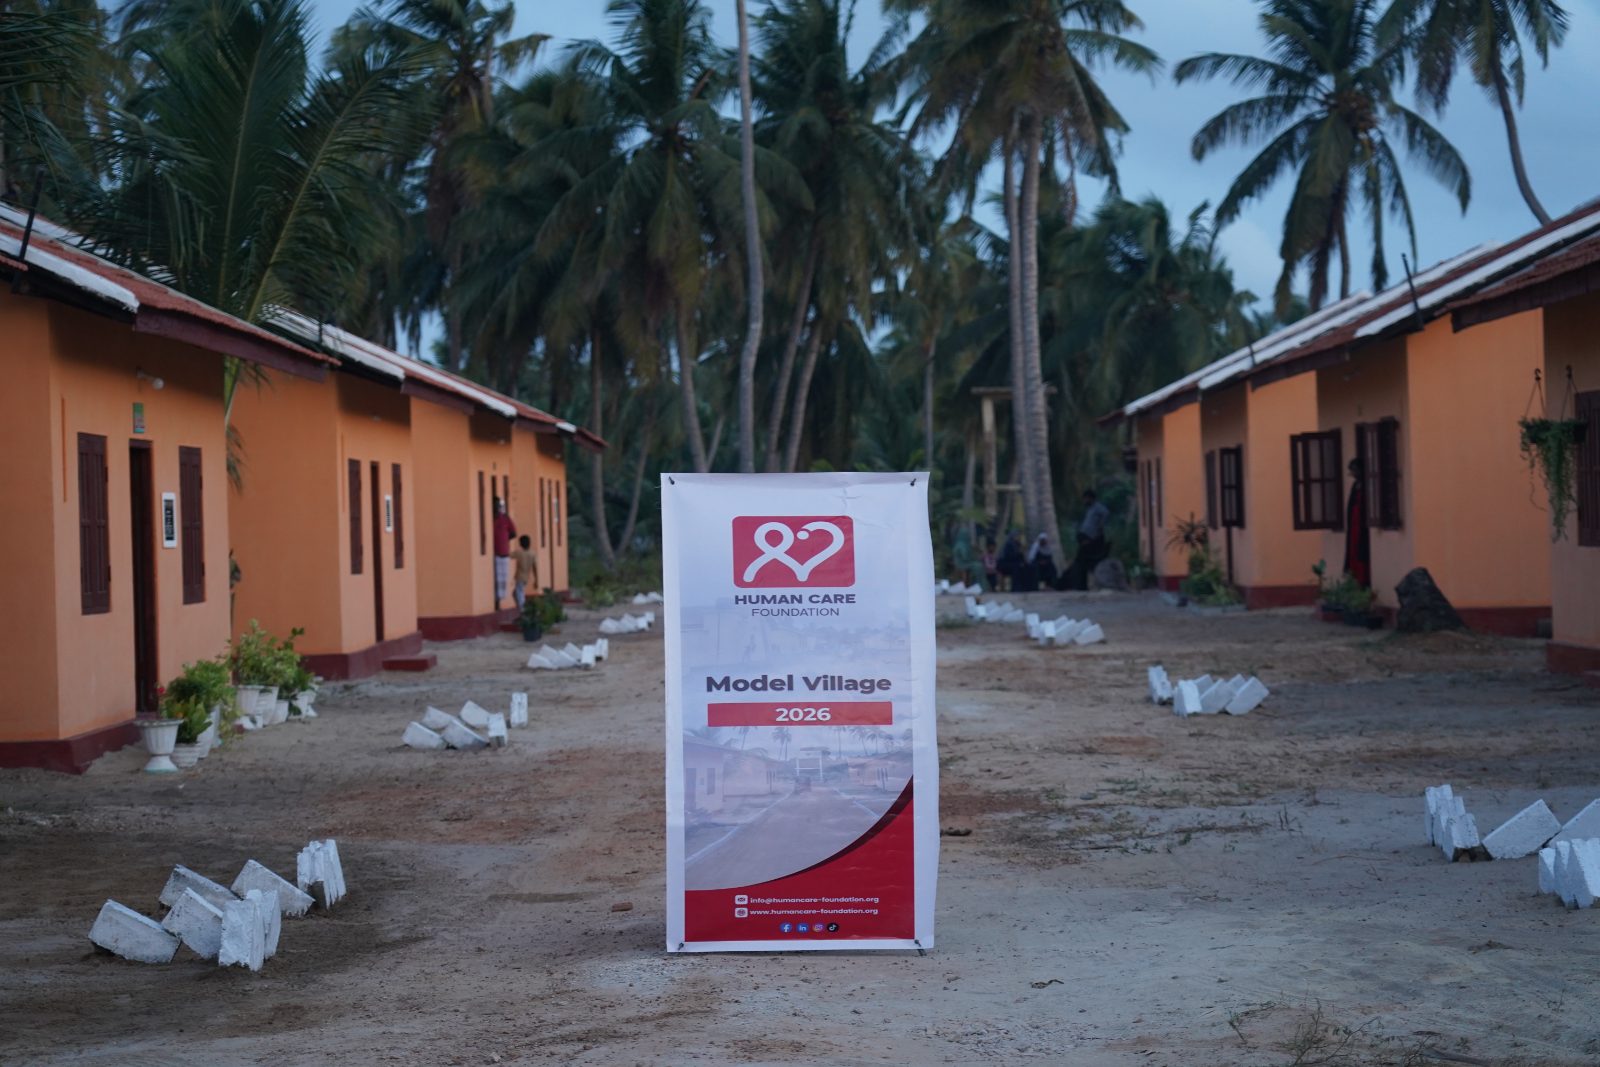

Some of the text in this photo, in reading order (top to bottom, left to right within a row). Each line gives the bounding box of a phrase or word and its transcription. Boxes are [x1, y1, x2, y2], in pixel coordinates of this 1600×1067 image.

[735, 594, 856, 605] HUMAN CARE
[751, 607, 840, 617] FOUNDATION
[706, 674, 892, 694] Model Village
[775, 707, 832, 722] 2026
[750, 896, 879, 904] info@humancare-foundation.org
